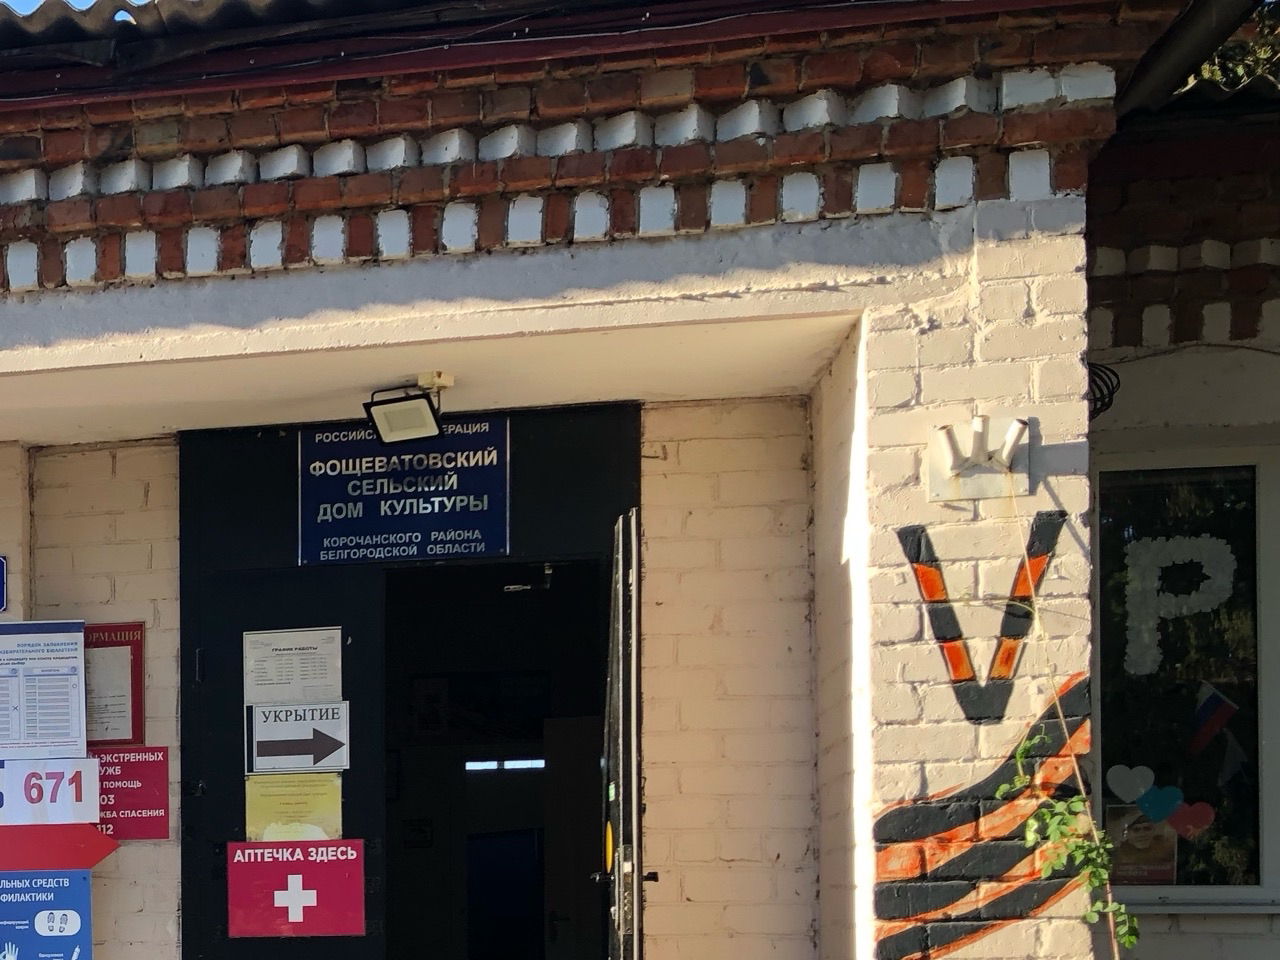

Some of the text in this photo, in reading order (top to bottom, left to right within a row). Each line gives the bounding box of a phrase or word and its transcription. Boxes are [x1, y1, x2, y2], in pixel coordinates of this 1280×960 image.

[315, 422, 489, 443] РОССИЙС ЕРАЦИЯ
[310, 447, 498, 477] ФОЩЕВАТОВСКИЙ
[348, 471, 458, 496] СЕЛЬСКИЙ
[317, 495, 488, 523] ДОМ КУЛЬТУРЫ
[323, 529, 482, 548] КОРОЧАНСКОГО РАЙОНА
[320, 542, 485, 561] БЕЛГОРОДСКОЙ ОБЛАСТИ
[897, 510, 1068, 726] V
[261, 708, 340, 723] УКРЫТИЕ
[100, 752, 163, 763] ЭКСТРЕННЫХ
[100, 766, 121, 775] УЖБ
[24, 770, 83, 804] 671
[103, 781, 142, 789] ПОМОЩЬ
[100, 795, 114, 805] 03
[119, 809, 165, 818] СПАСЕНИЯ
[233, 847, 357, 862] АПТЕЧКА ЗДЕСЬ
[32, 878, 69, 888] СРЕДСТВ
